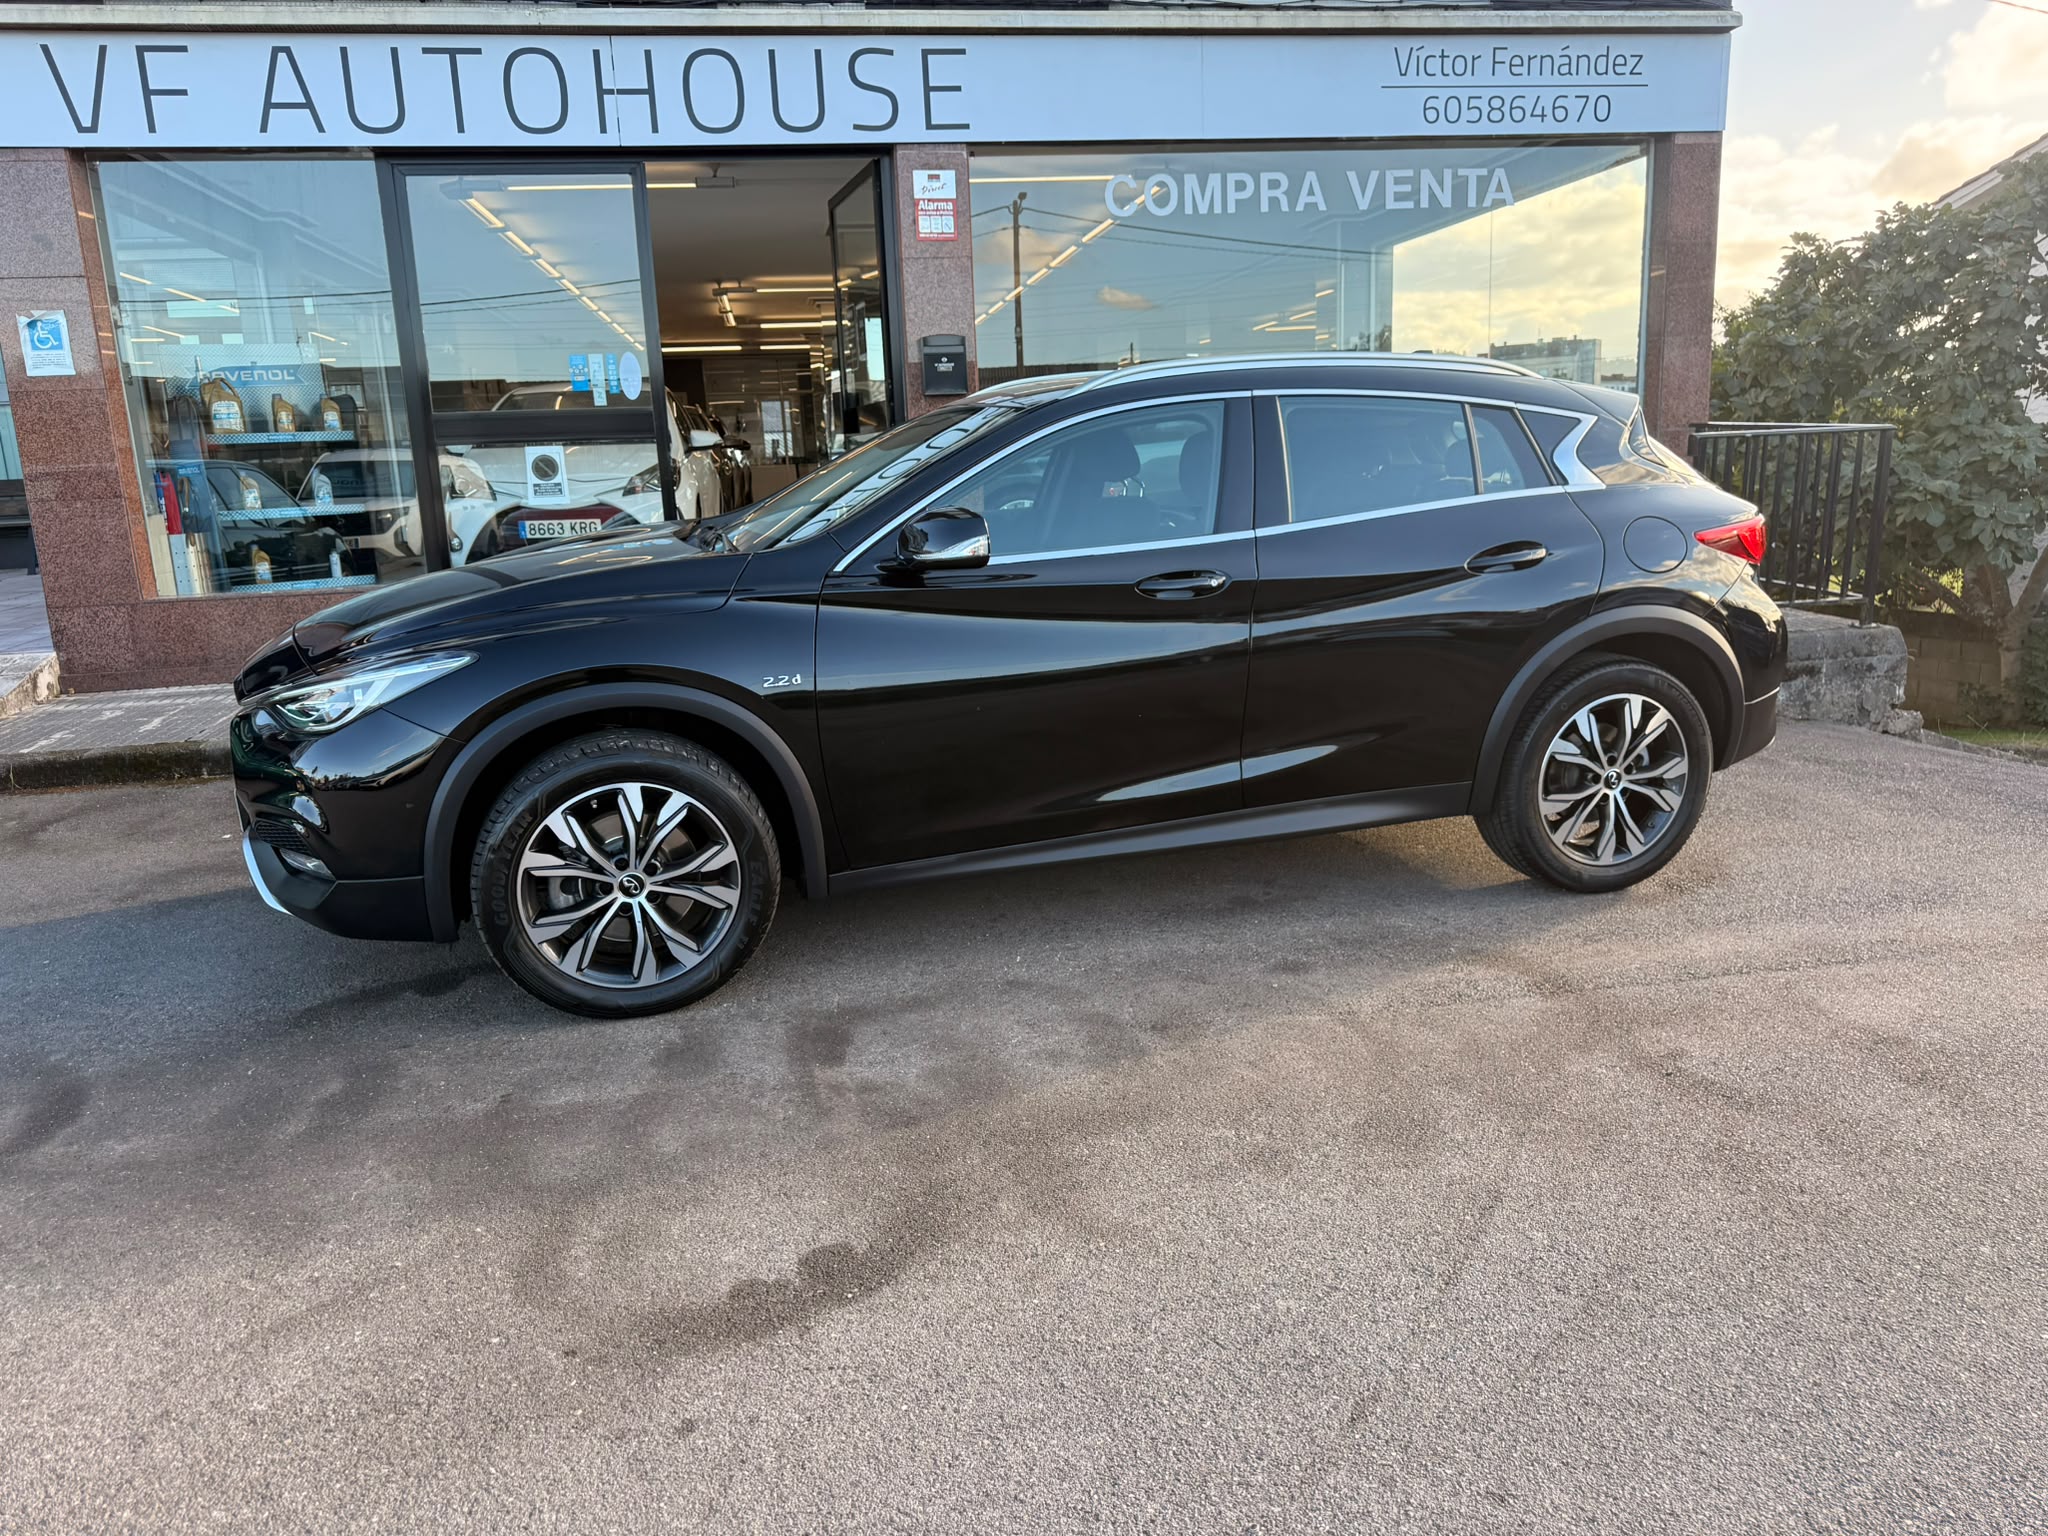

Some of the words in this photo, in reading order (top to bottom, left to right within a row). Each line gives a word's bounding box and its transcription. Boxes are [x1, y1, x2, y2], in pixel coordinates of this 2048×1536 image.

[1394, 46, 1481, 77] Víctor
[1491, 45, 1643, 77] Fernández
[40, 44, 189, 133] VF
[260, 45, 971, 134] AUTOHOUSE
[1423, 94, 1612, 124] 605864670
[918, 199, 953, 210] Alarma
[1104, 170, 1327, 218] COMPRA
[1345, 167, 1514, 211] VENTA
[528, 522, 565, 536] 8663
[569, 521, 598, 535] KRG
